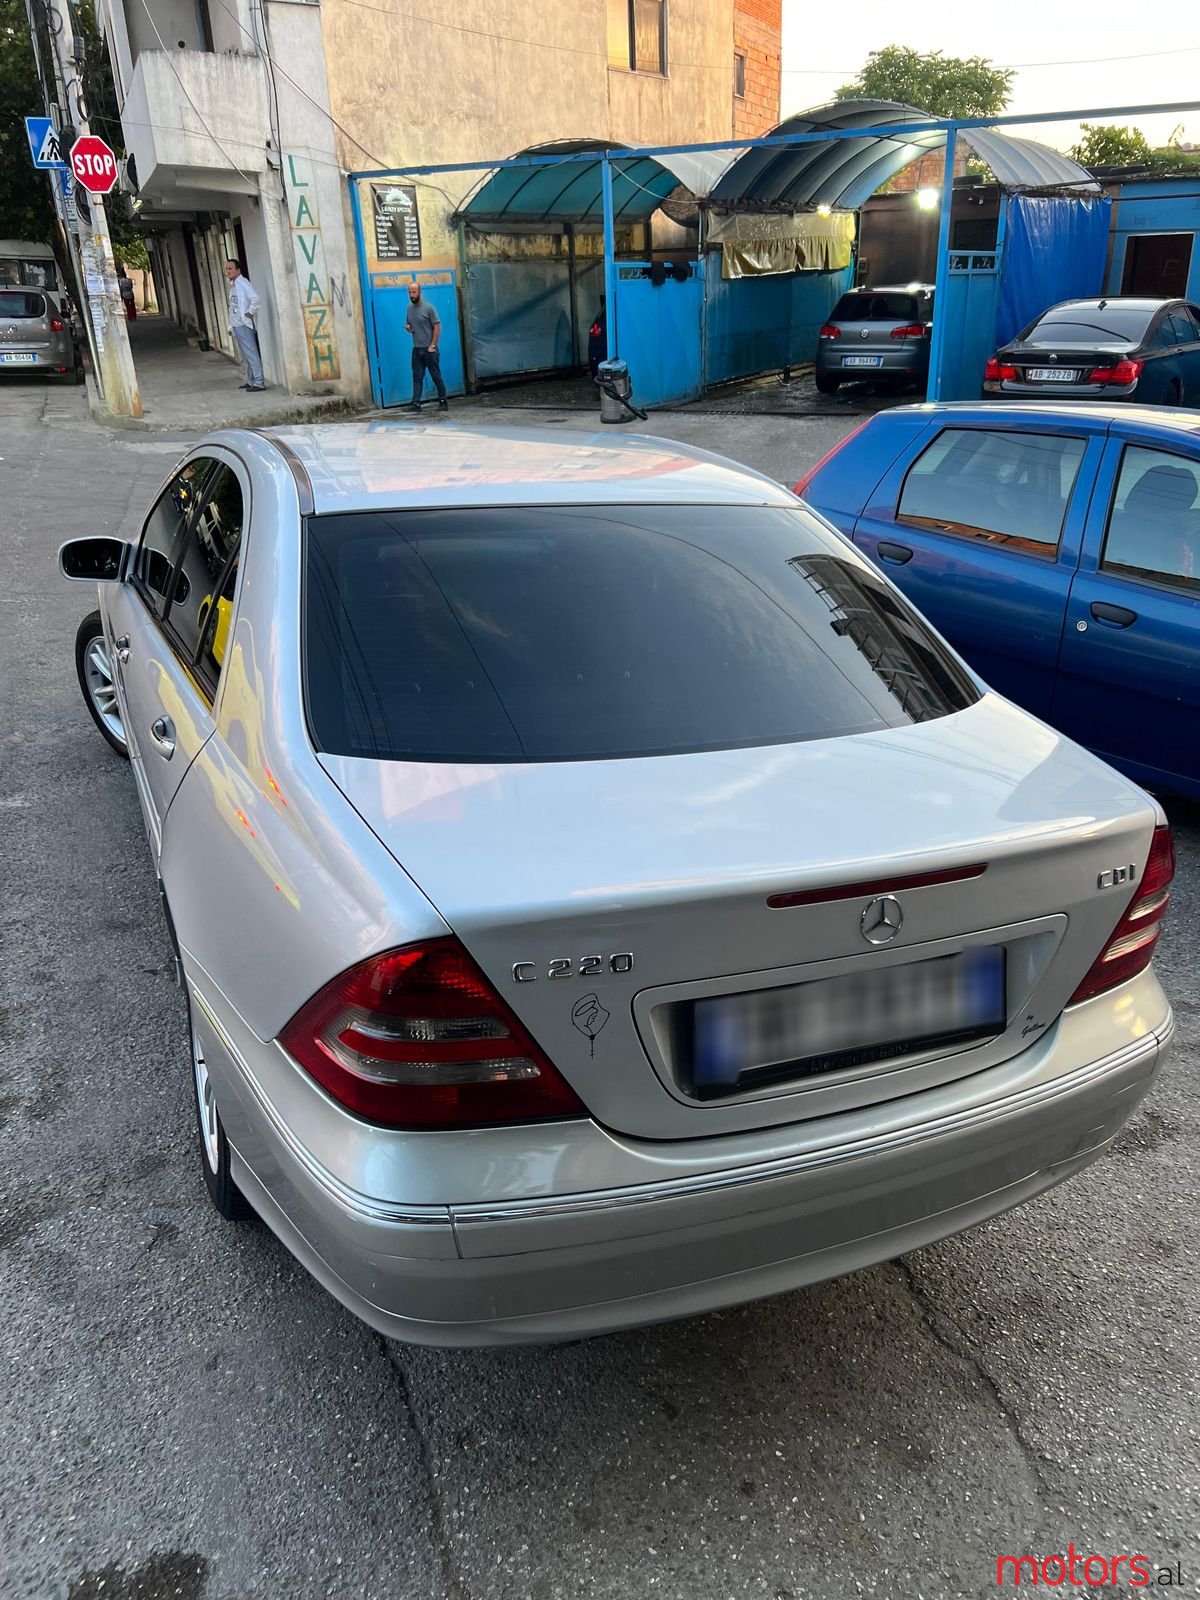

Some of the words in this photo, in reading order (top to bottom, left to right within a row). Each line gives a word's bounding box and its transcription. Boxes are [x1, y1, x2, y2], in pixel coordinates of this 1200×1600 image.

[74, 154, 113, 176] STOP
[287, 154, 335, 375] LAVAZH
[1033, 370, 1044, 379] AB
[1046, 370, 1062, 380] 252
[1096, 863, 1136, 890] CDI
[511, 961, 538, 983] C
[548, 952, 634, 979] 220
